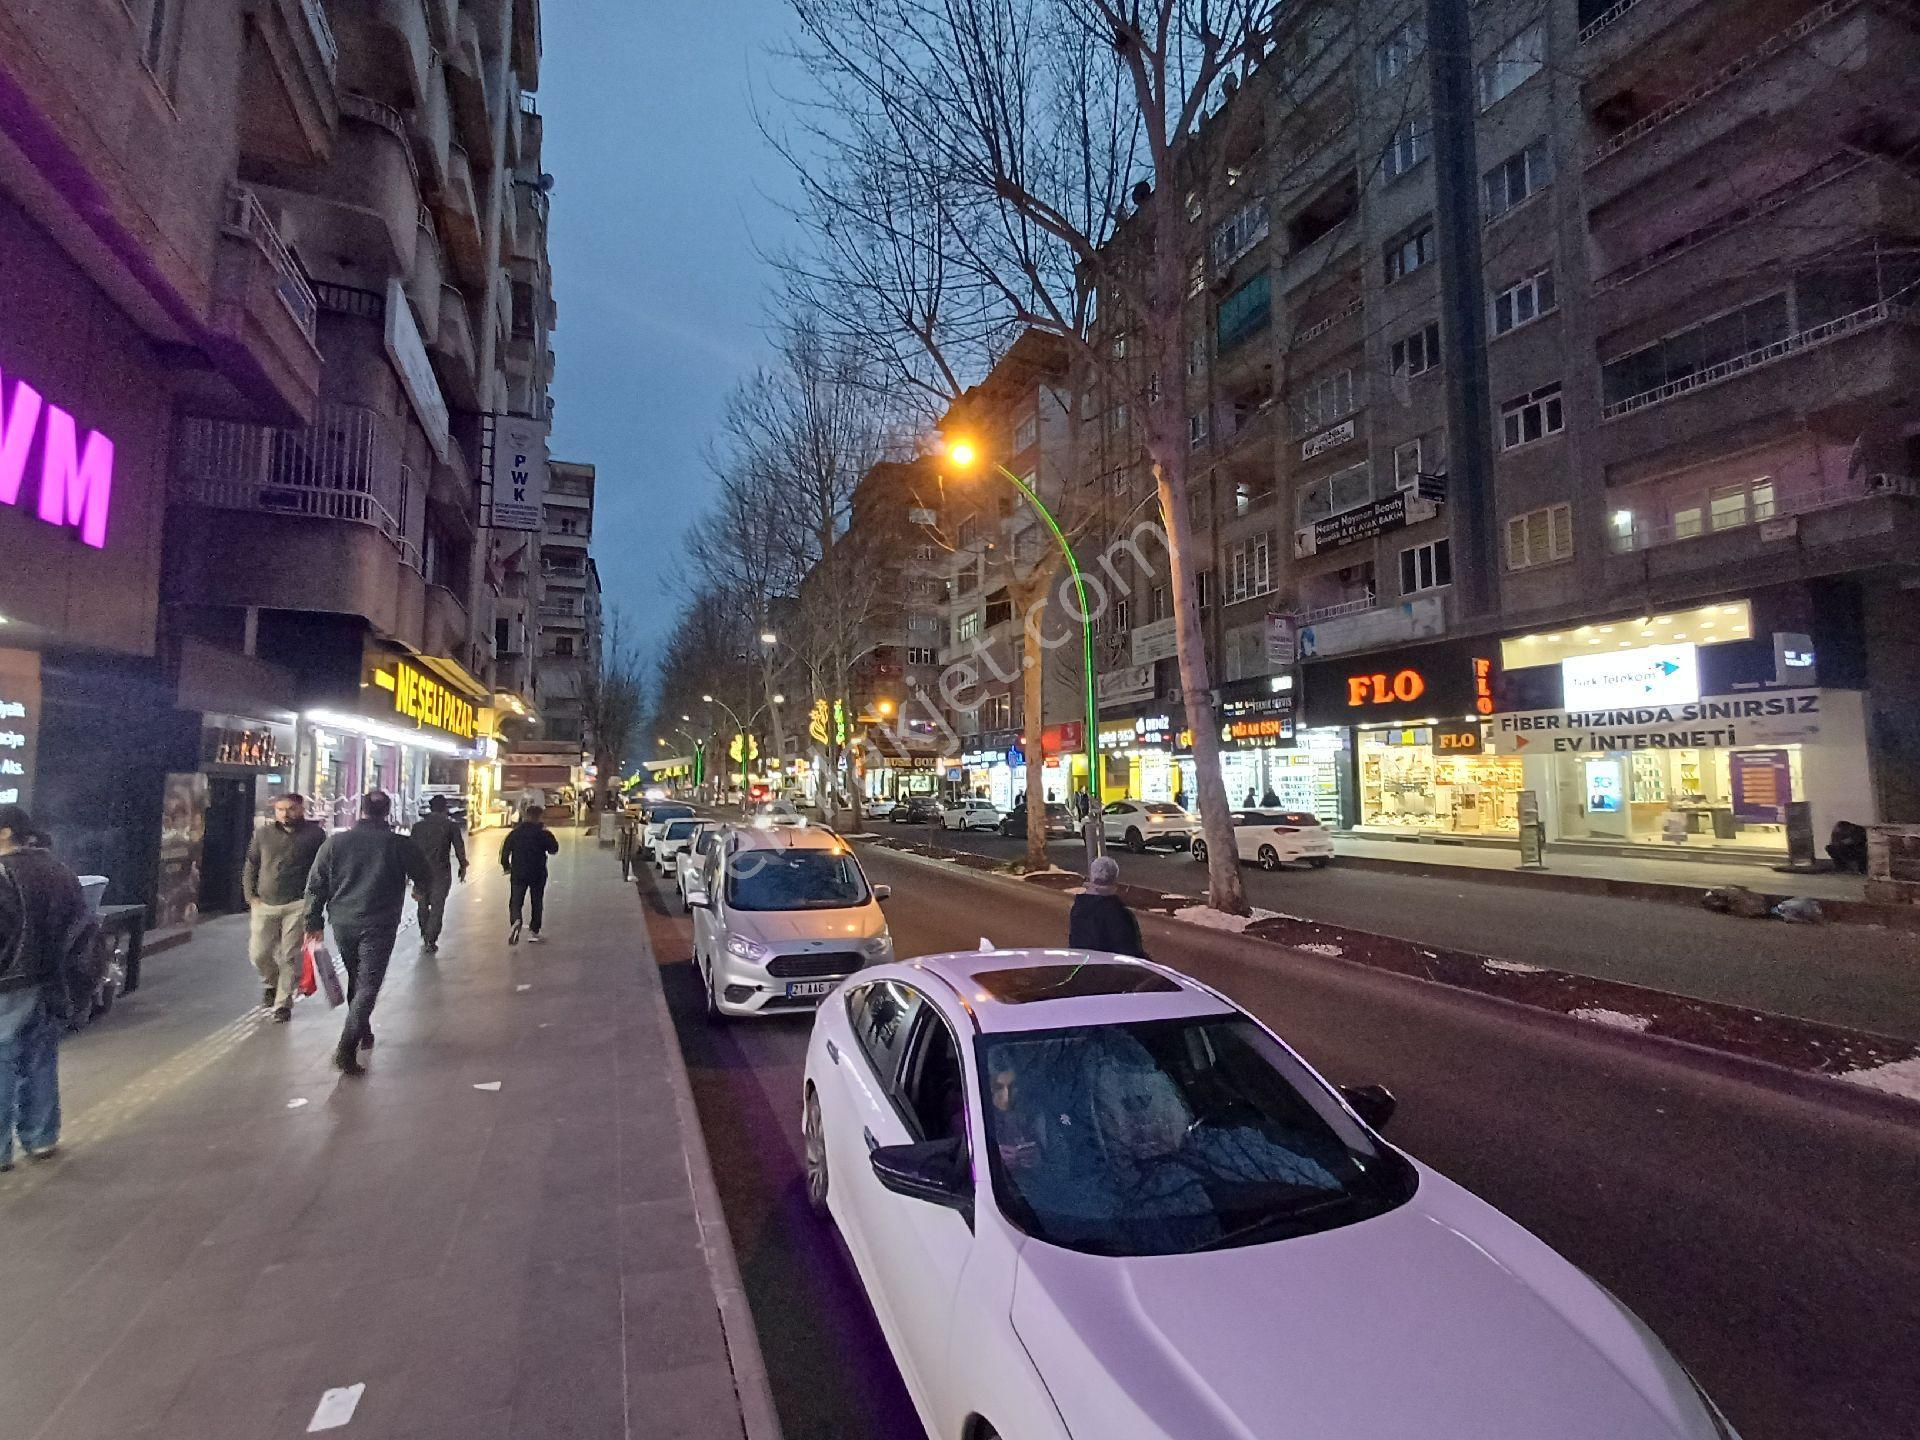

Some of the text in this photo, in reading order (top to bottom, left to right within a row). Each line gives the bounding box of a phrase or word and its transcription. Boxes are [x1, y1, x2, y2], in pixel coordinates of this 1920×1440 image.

[511, 455, 528, 501] PWK
[1348, 670, 1424, 706] FLO
[1477, 659, 1493, 714] FLO
[1603, 672, 1657, 685] Telekom
[396, 662, 474, 738] NEŞELİ PAZAR
[1501, 695, 1820, 732] FİBER HIZINDA SINIRSIZ
[1439, 733, 1475, 749] FLO
[1554, 737, 1583, 751] EV
[1590, 724, 1737, 751] İNTERNETİ
